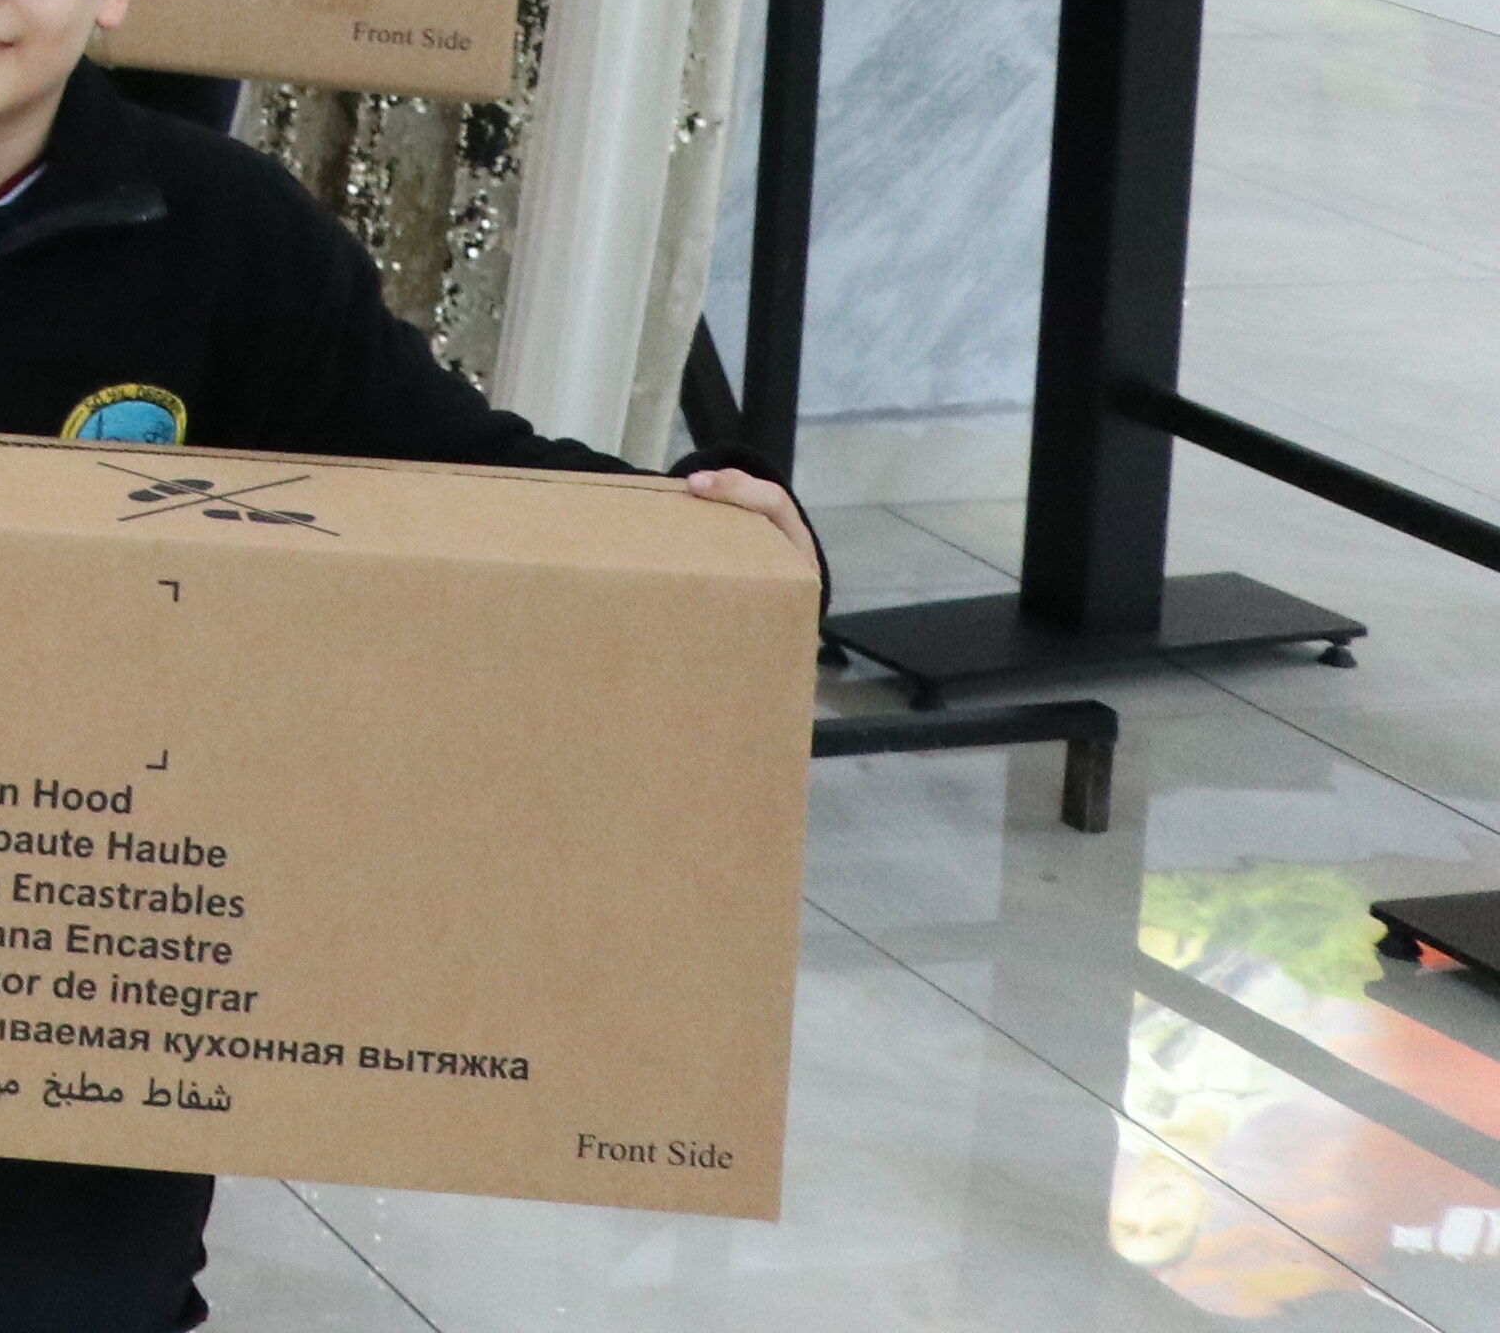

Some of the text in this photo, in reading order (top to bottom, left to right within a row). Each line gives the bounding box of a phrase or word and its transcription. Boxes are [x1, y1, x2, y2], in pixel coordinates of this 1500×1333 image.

[353, 20, 472, 52] Front Side
[33, 778, 133, 815] Hood
[107, 830, 228, 869] Haube
[12, 872, 245, 919] Encastrables
[66, 923, 233, 966] Encastre
[52, 970, 97, 1001] de
[110, 973, 259, 1017] integrar
[164, 1031, 345, 1067] кухонная
[358, 1046, 529, 1081] вытяжка
[42, 1071, 124, 1109] مطبخ
[141, 1077, 232, 1113] شفاط
[577, 1133, 734, 1170] Front Side
